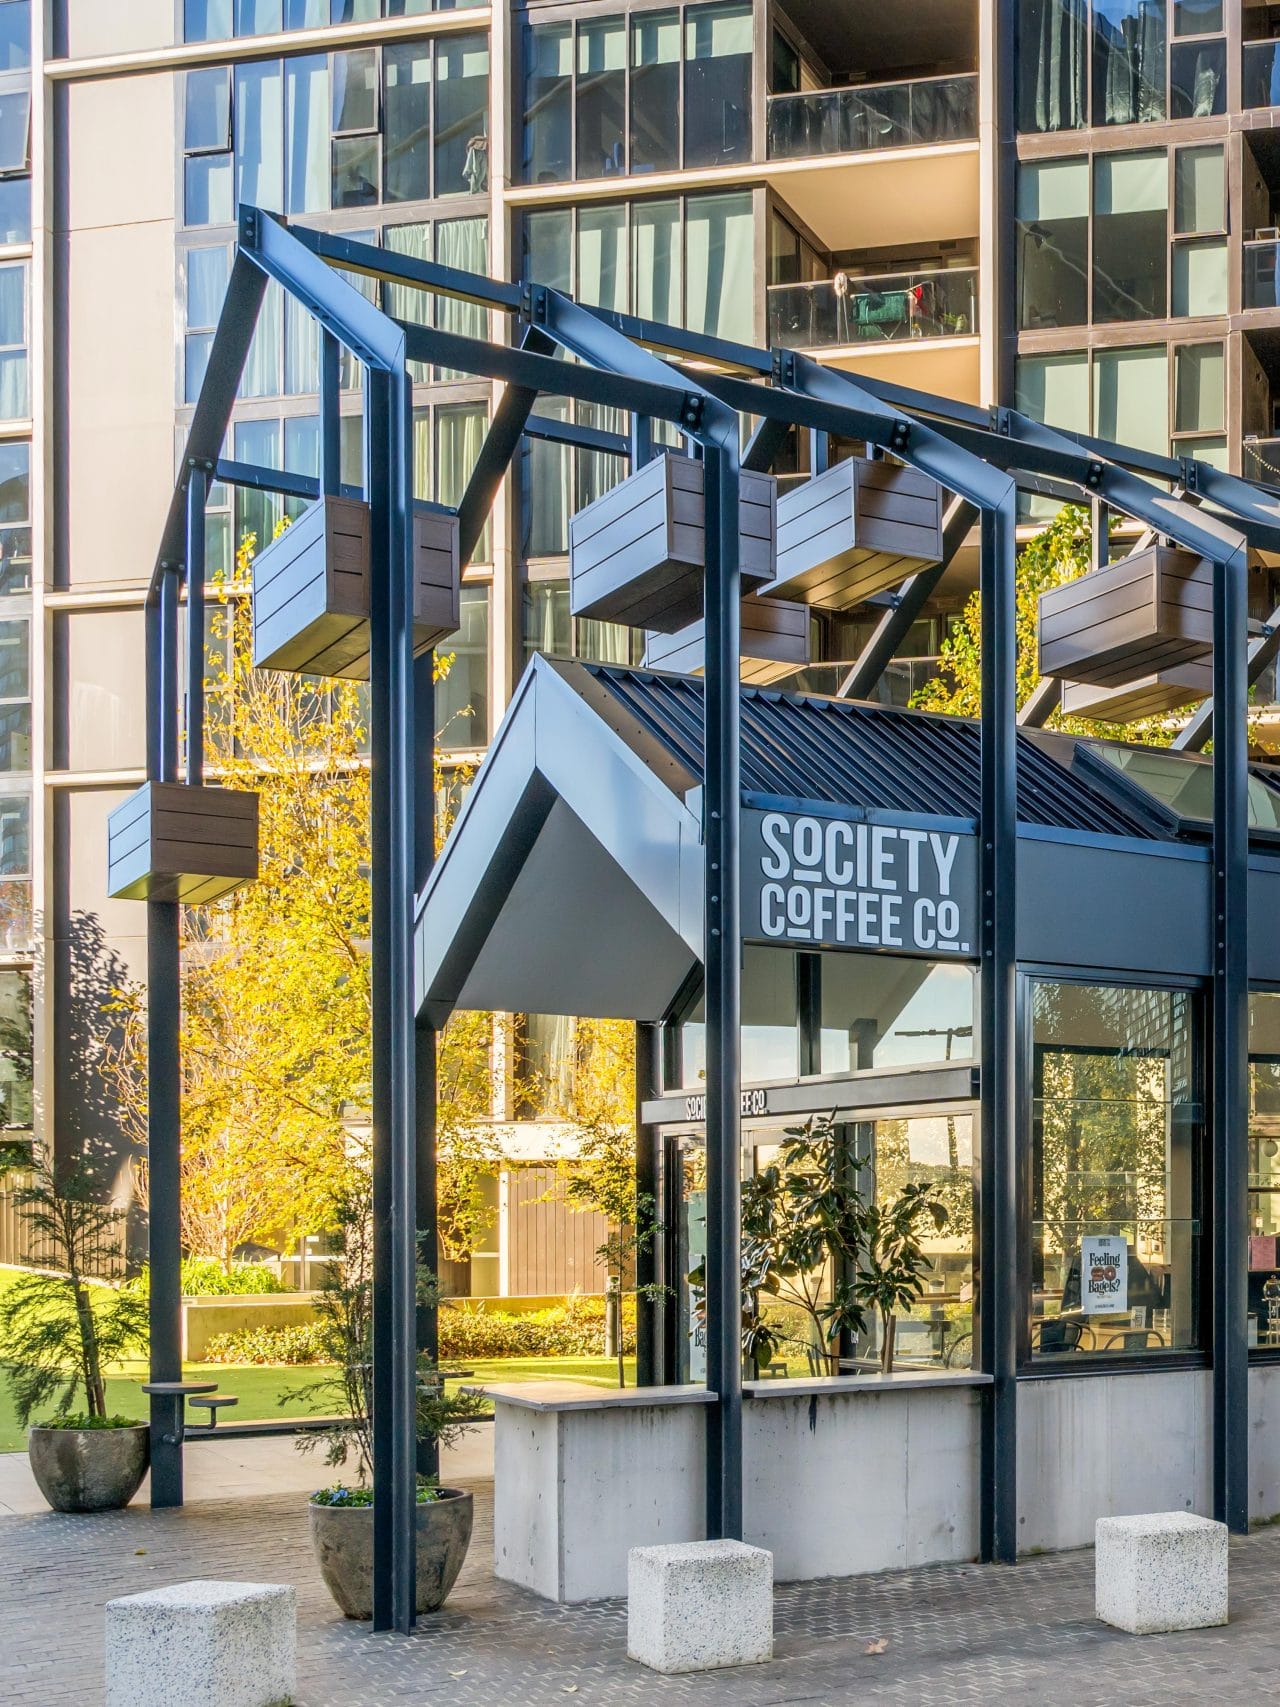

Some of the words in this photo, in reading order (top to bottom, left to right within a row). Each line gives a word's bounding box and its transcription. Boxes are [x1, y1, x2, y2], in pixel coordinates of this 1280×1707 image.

[760, 813, 960, 896] SOCIETY
[761, 882, 903, 947] COFFEE
[912, 897, 970, 952] CO.
[685, 1095, 706, 1121] SOCI
[1089, 1252, 1121, 1269] Feeling
[1088, 1279, 1121, 1296] Bagels?
